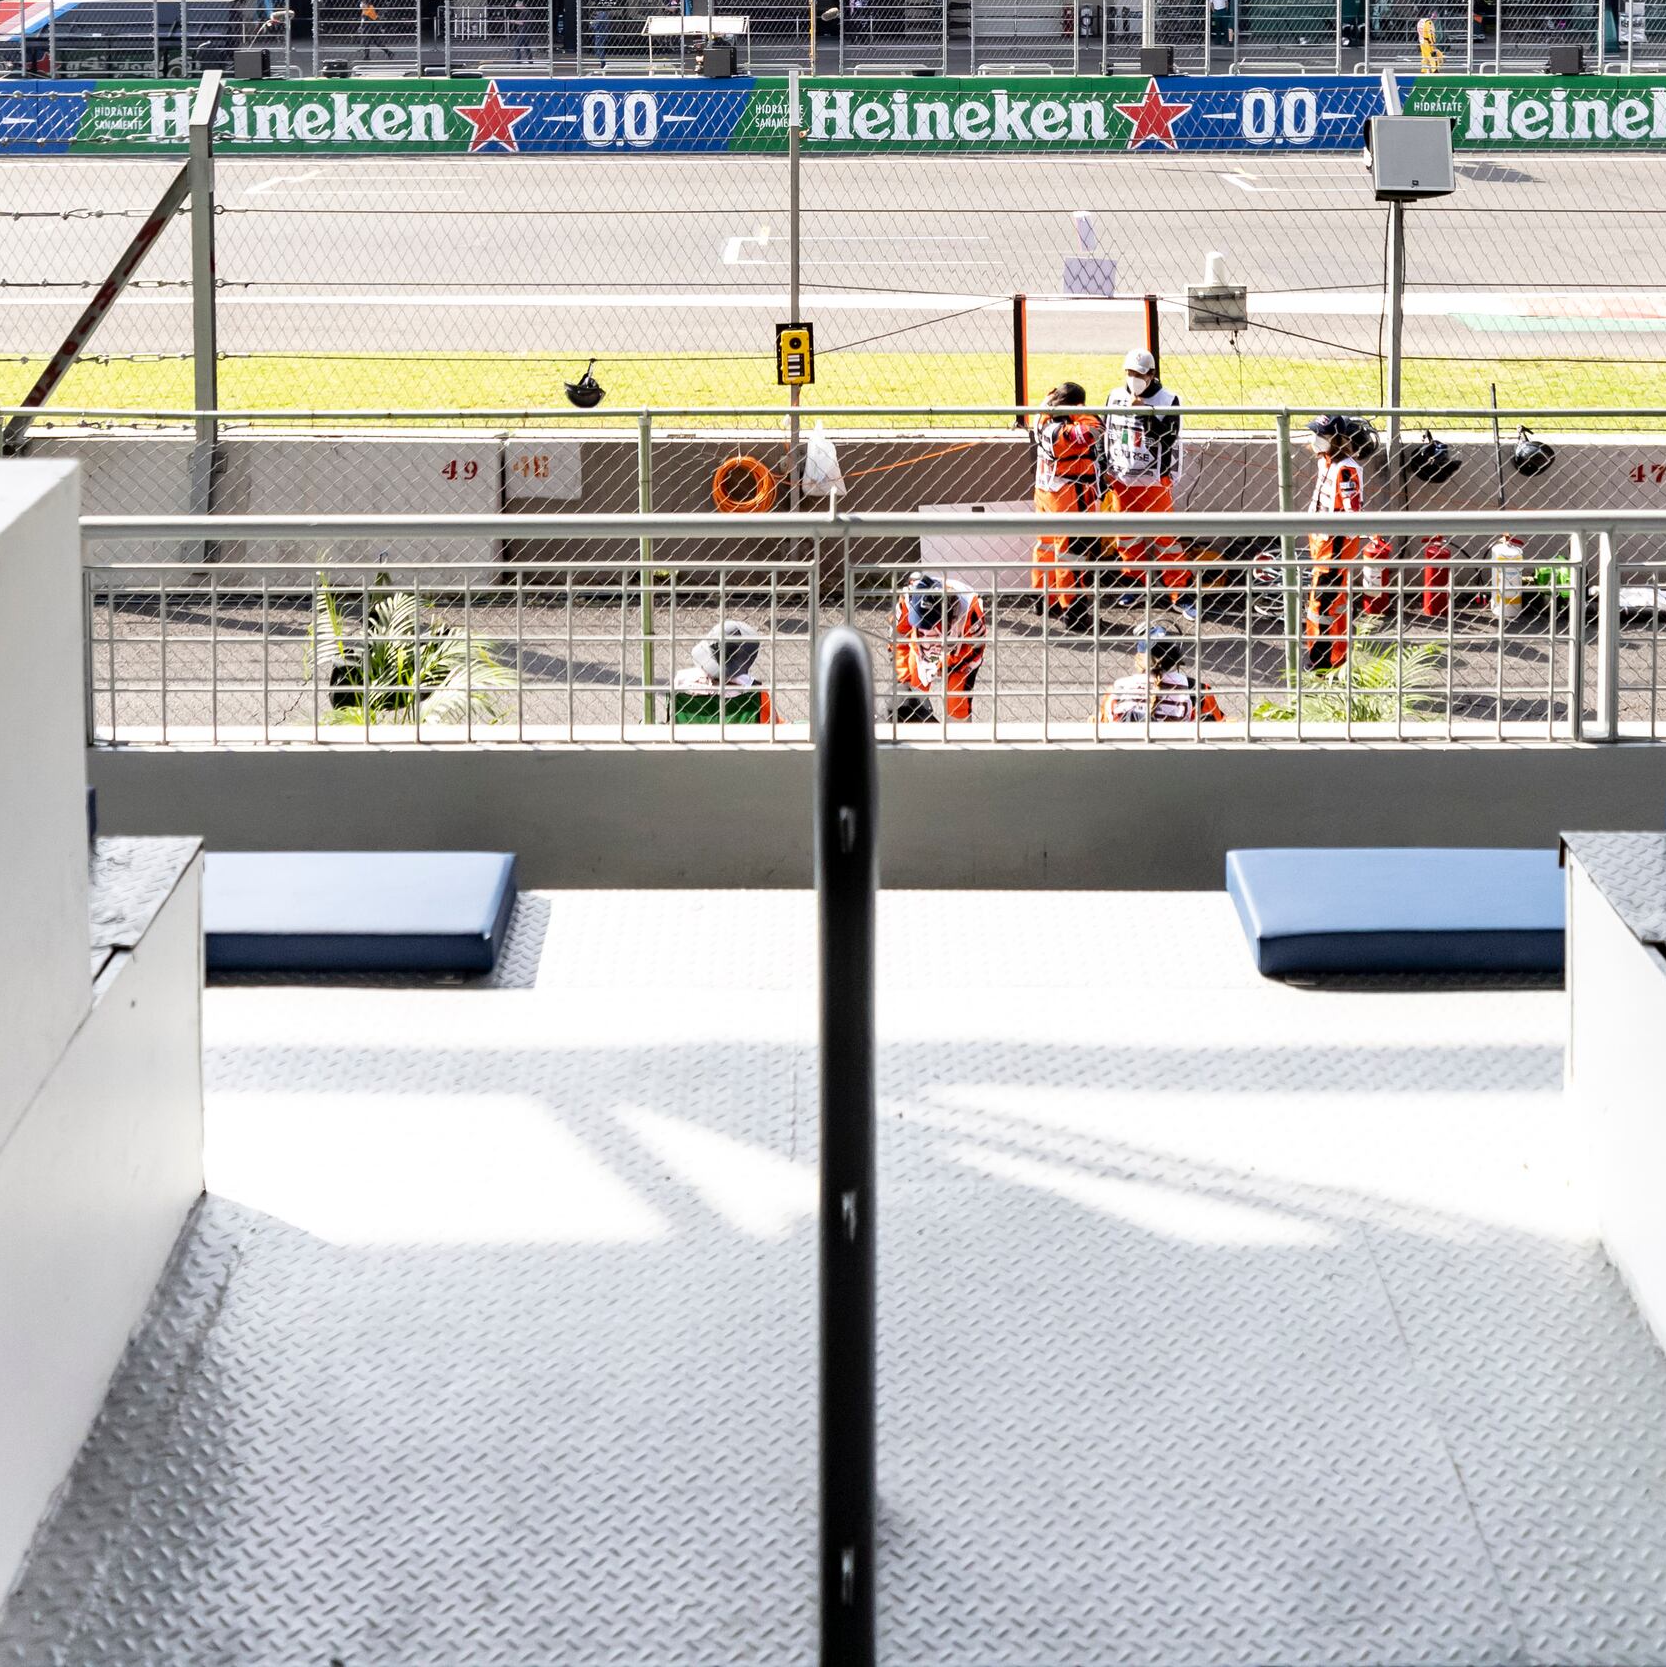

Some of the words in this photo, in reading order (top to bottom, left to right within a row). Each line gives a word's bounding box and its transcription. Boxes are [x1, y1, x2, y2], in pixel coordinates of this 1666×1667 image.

[95, 120, 143, 131] SANAMENTE
[582, 90, 658, 148] 0.0
[807, 90, 1109, 141] Heineken
[1241, 87, 1317, 144] 0.0
[442, 460, 478, 480] 49
